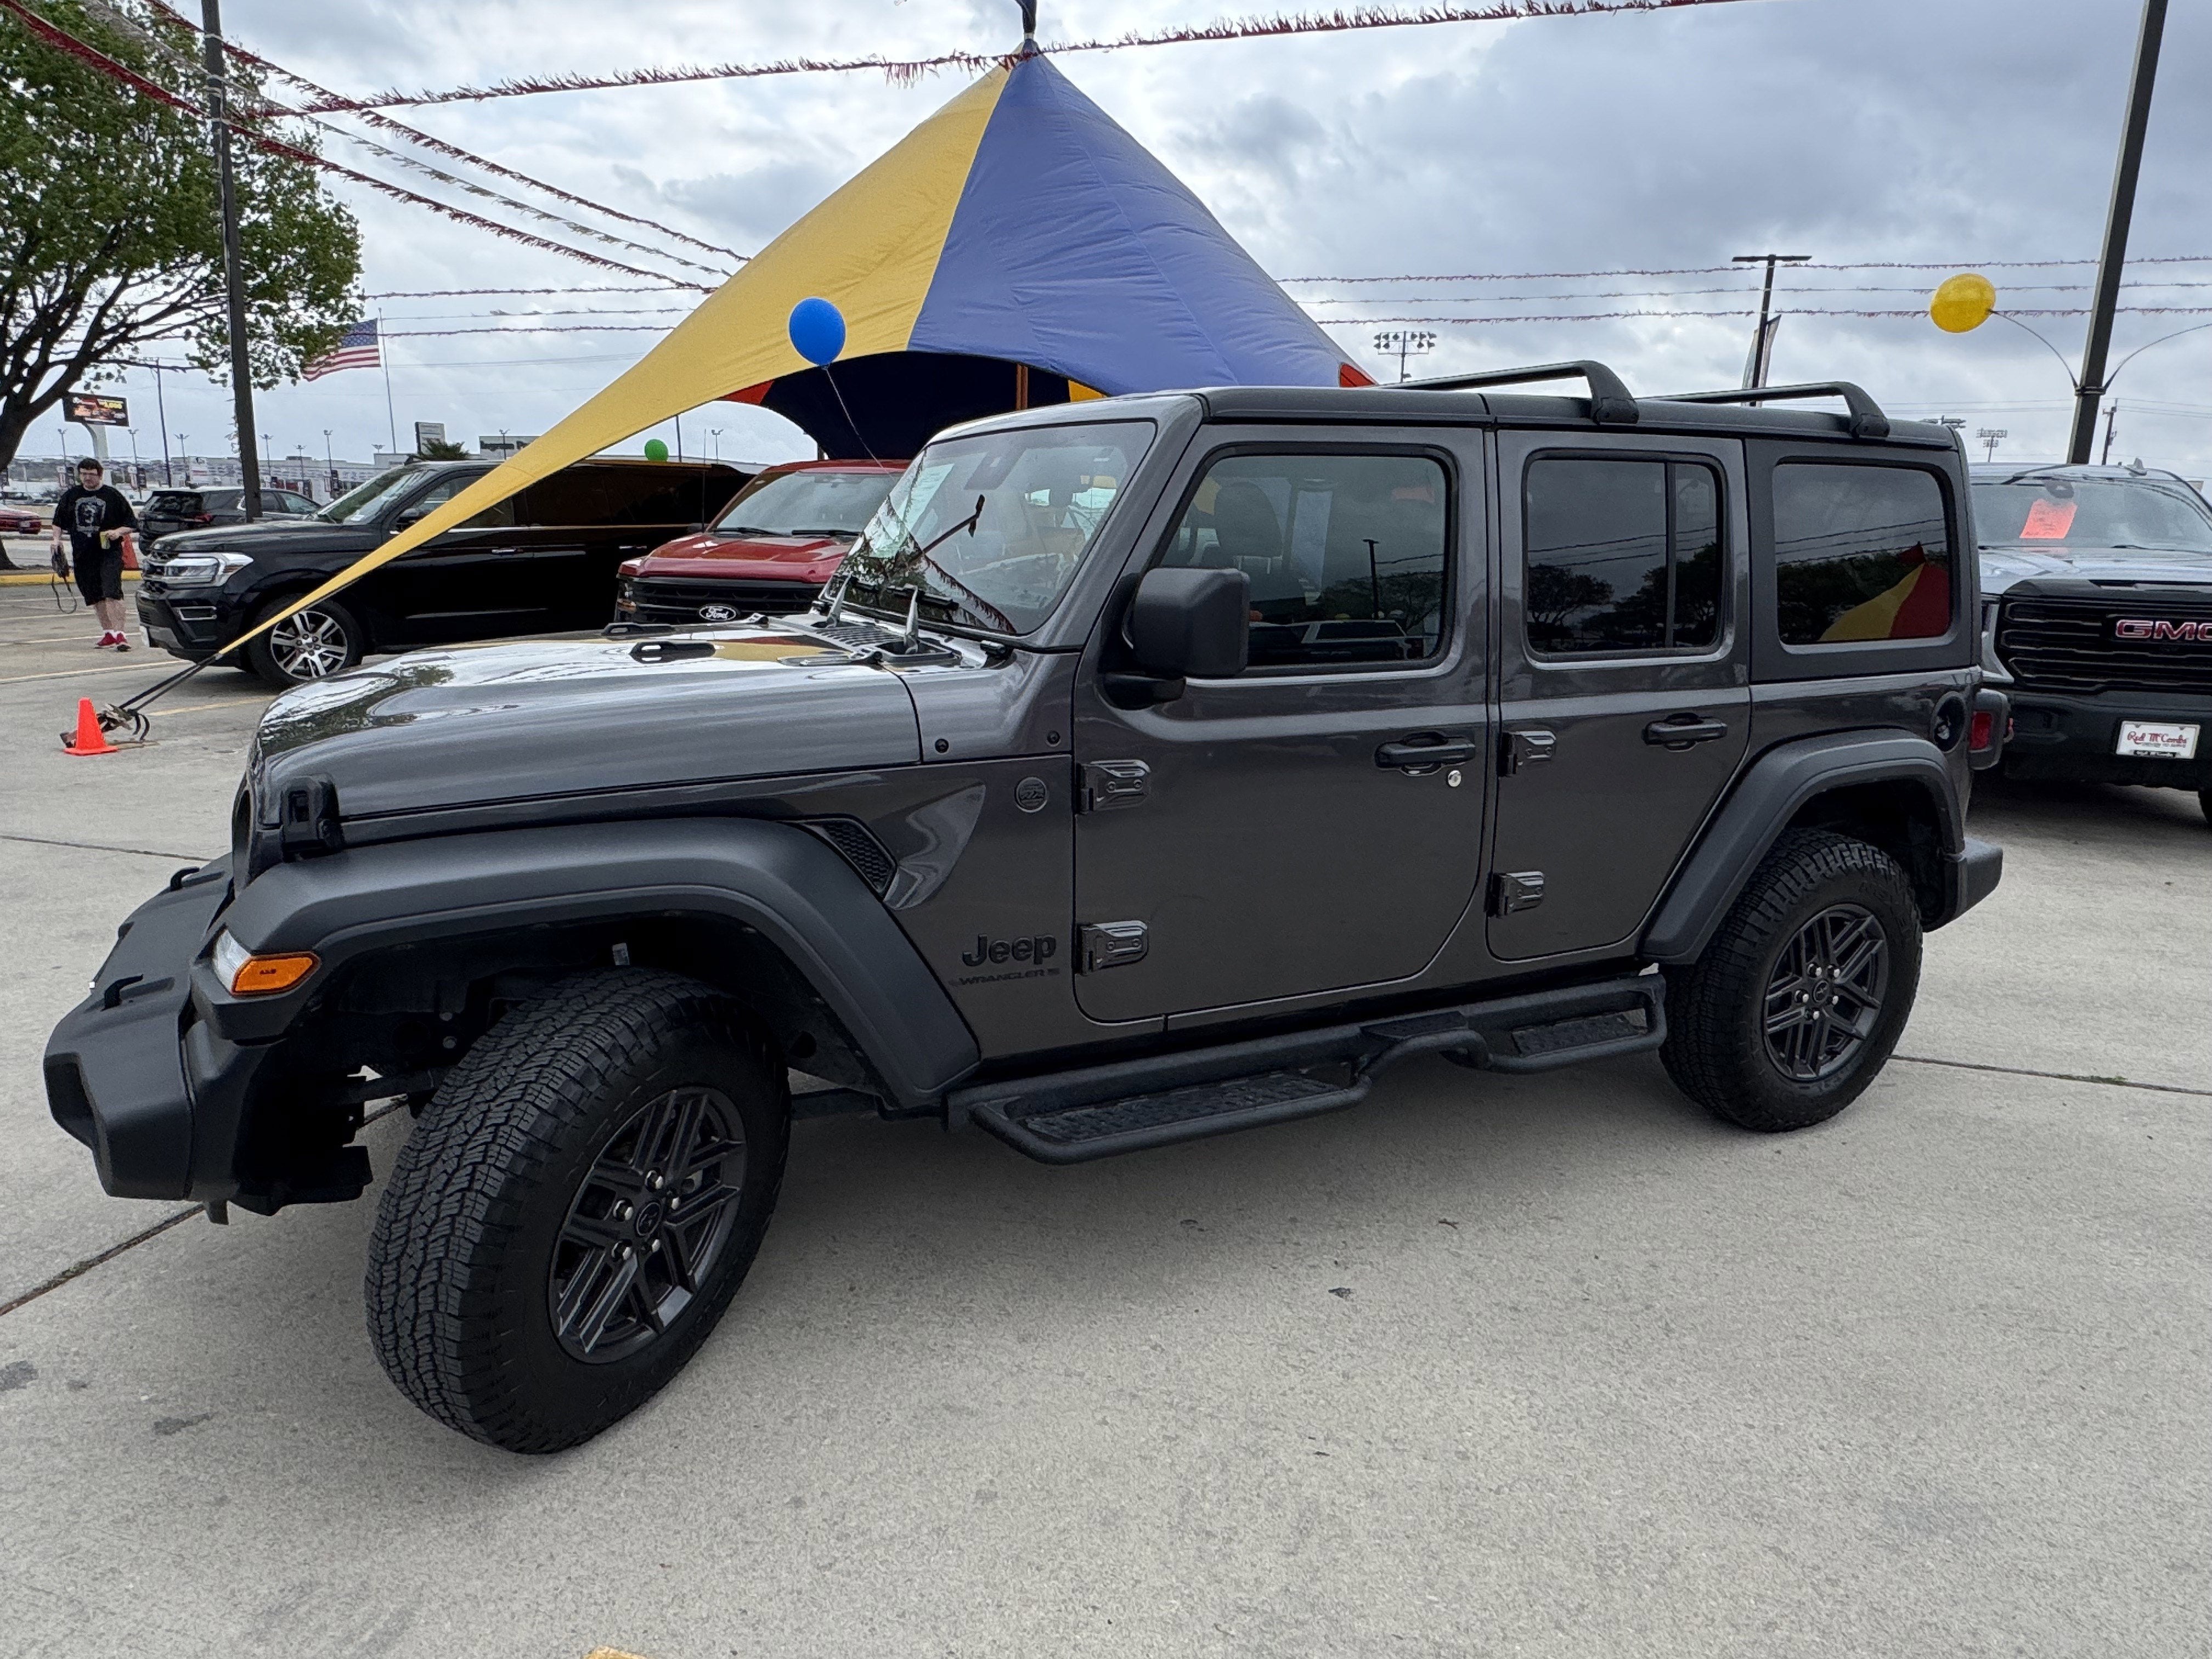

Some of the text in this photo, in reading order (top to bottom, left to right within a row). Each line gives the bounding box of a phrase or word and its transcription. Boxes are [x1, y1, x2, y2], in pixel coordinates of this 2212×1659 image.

[706, 606, 730, 619] Ford
[2127, 731, 2146, 744] Red
[962, 934, 1057, 967] Jeep
[959, 969, 1045, 985] WRANGLER
